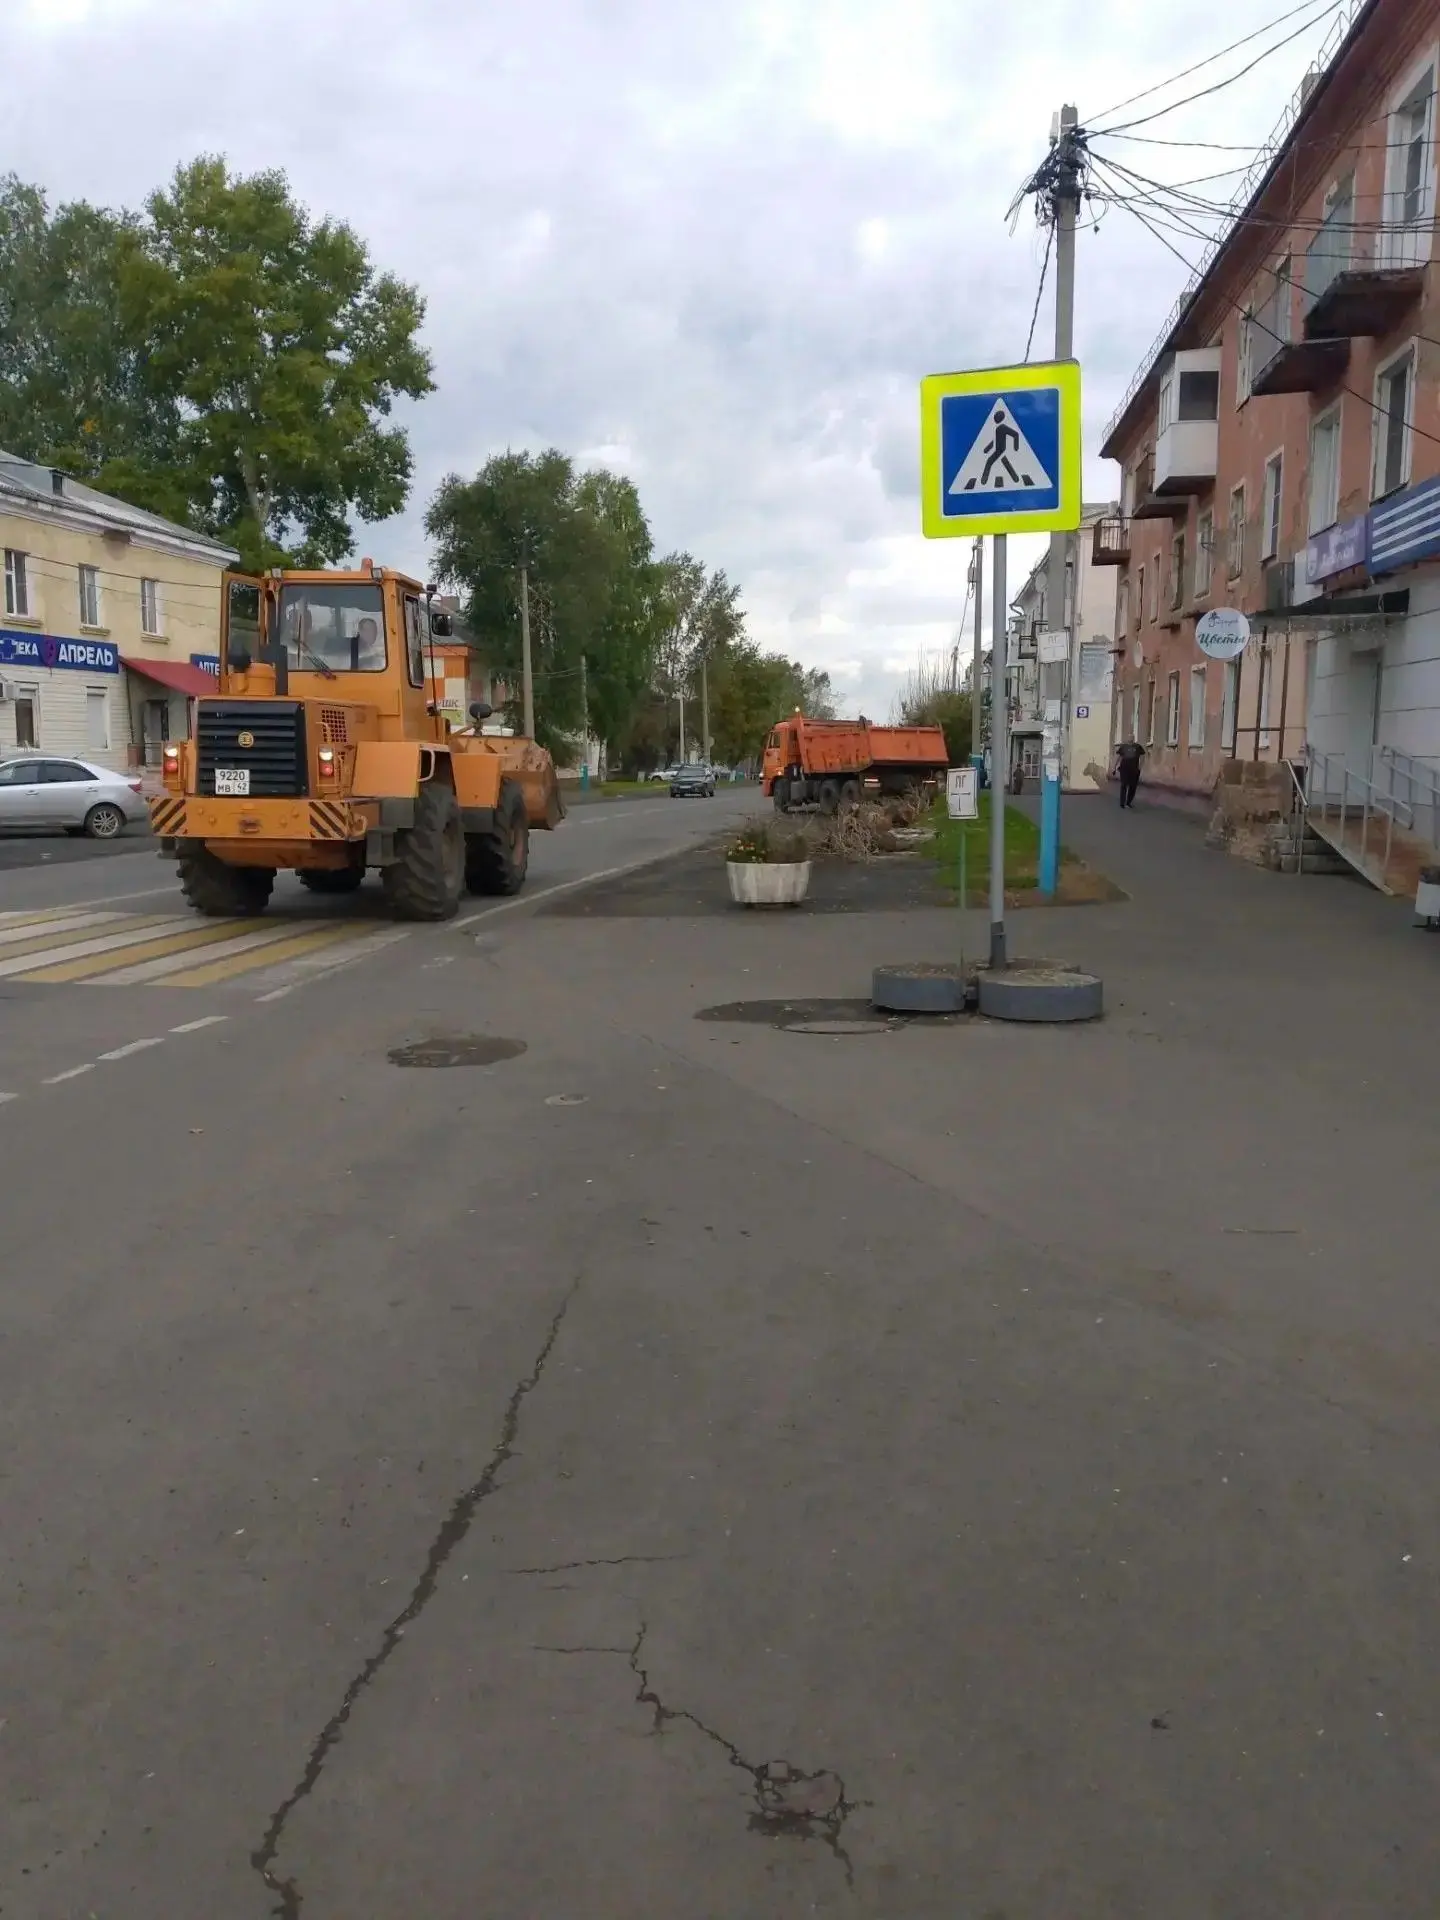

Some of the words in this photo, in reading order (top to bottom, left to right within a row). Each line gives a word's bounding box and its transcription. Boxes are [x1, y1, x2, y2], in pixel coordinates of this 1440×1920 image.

[1198, 633, 1246, 647] Цветы
[58, 643, 114, 667] АПРЕЛЬ
[1078, 706, 1087, 718] 9
[219, 770, 245, 781] 9220
[955, 775, 967, 789] ПГ
[217, 784, 231, 793] МВ
[237, 782, 248, 791] 42
